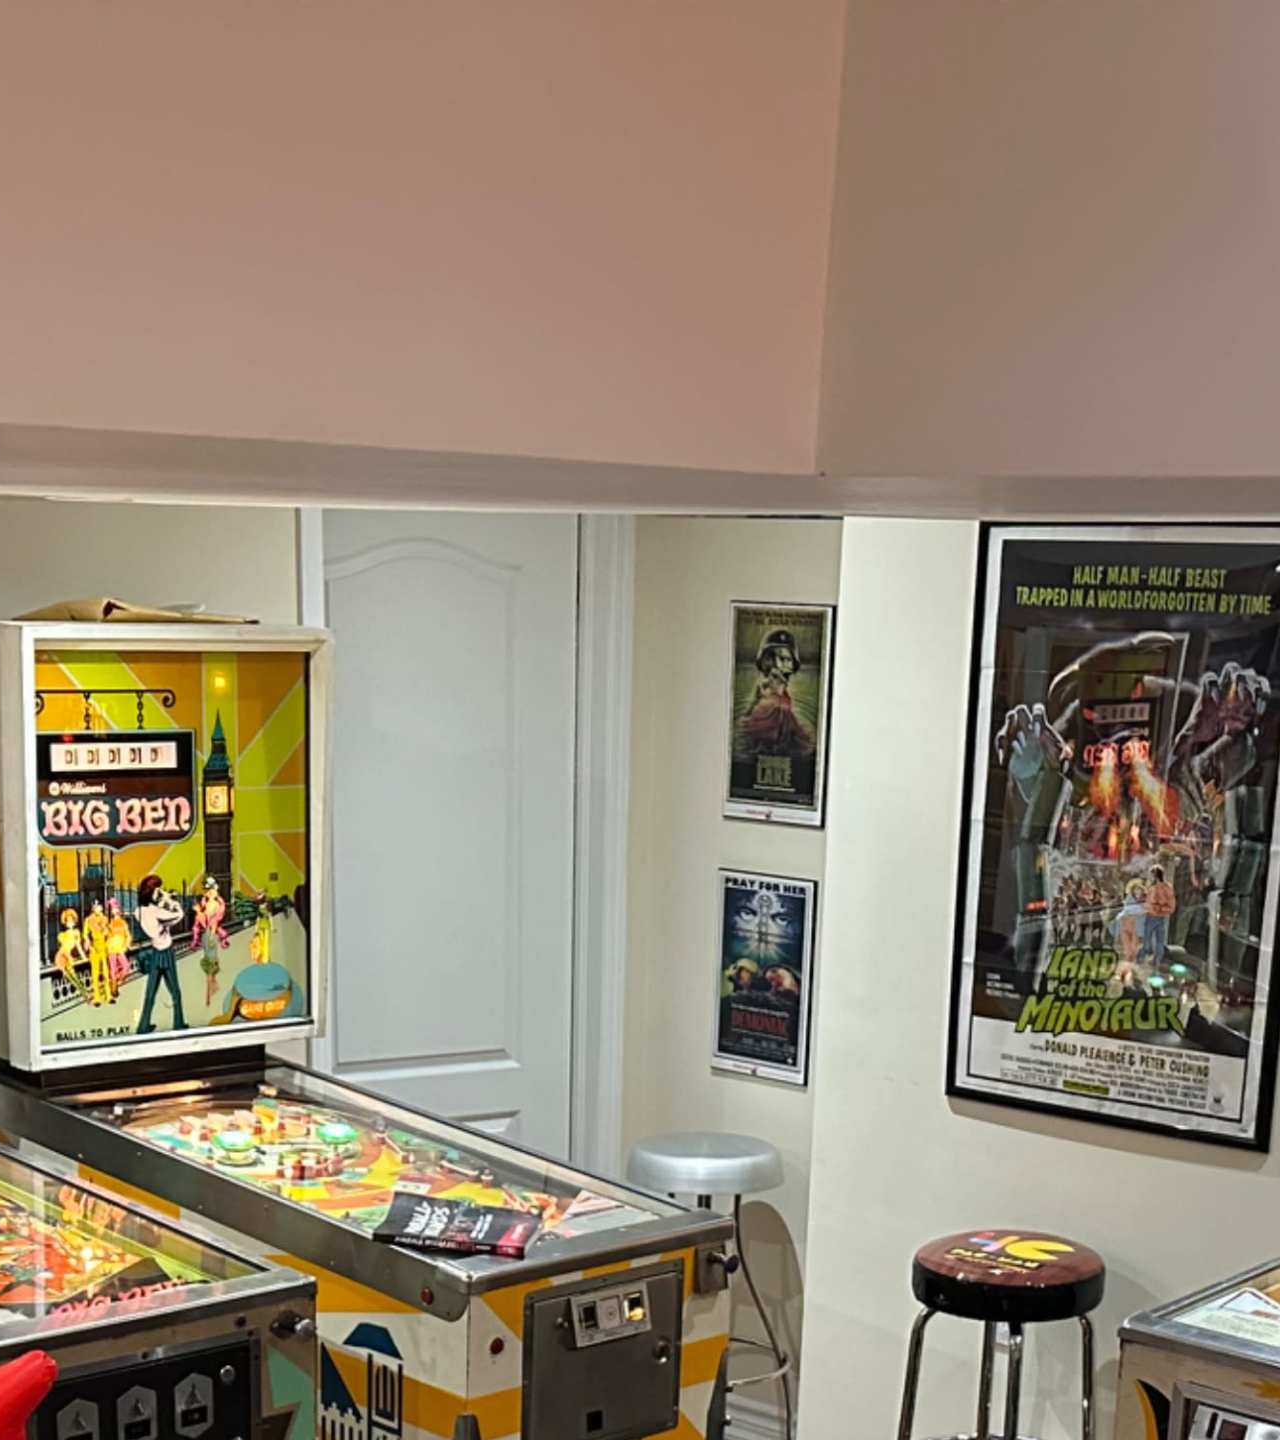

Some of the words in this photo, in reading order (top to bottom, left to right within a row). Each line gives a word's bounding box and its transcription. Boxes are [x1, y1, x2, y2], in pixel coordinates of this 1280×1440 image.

[1073, 566, 1103, 585] HALF
[1186, 568, 1227, 589] BEAST
[1016, 586, 1068, 607] TRAPPED
[1071, 588, 1084, 607] IN
[1086, 589, 1095, 608] A
[1220, 594, 1238, 614] BY
[1240, 595, 1271, 615] TIME
[41, 799, 110, 837] BIG
[115, 796, 191, 833] BEN
[725, 876, 756, 889] PRAY
[759, 880, 780, 892] FOR
[782, 883, 807, 897] HER
[1047, 947, 1117, 980] LAND
[1078, 979, 1106, 997] the
[56, 1029, 87, 1042] BALLS
[91, 1027, 103, 1039] TO
[107, 1026, 130, 1036] PLAY
[1045, 1039, 1077, 1057] DONALD
[1140, 1054, 1166, 1071] PETER
